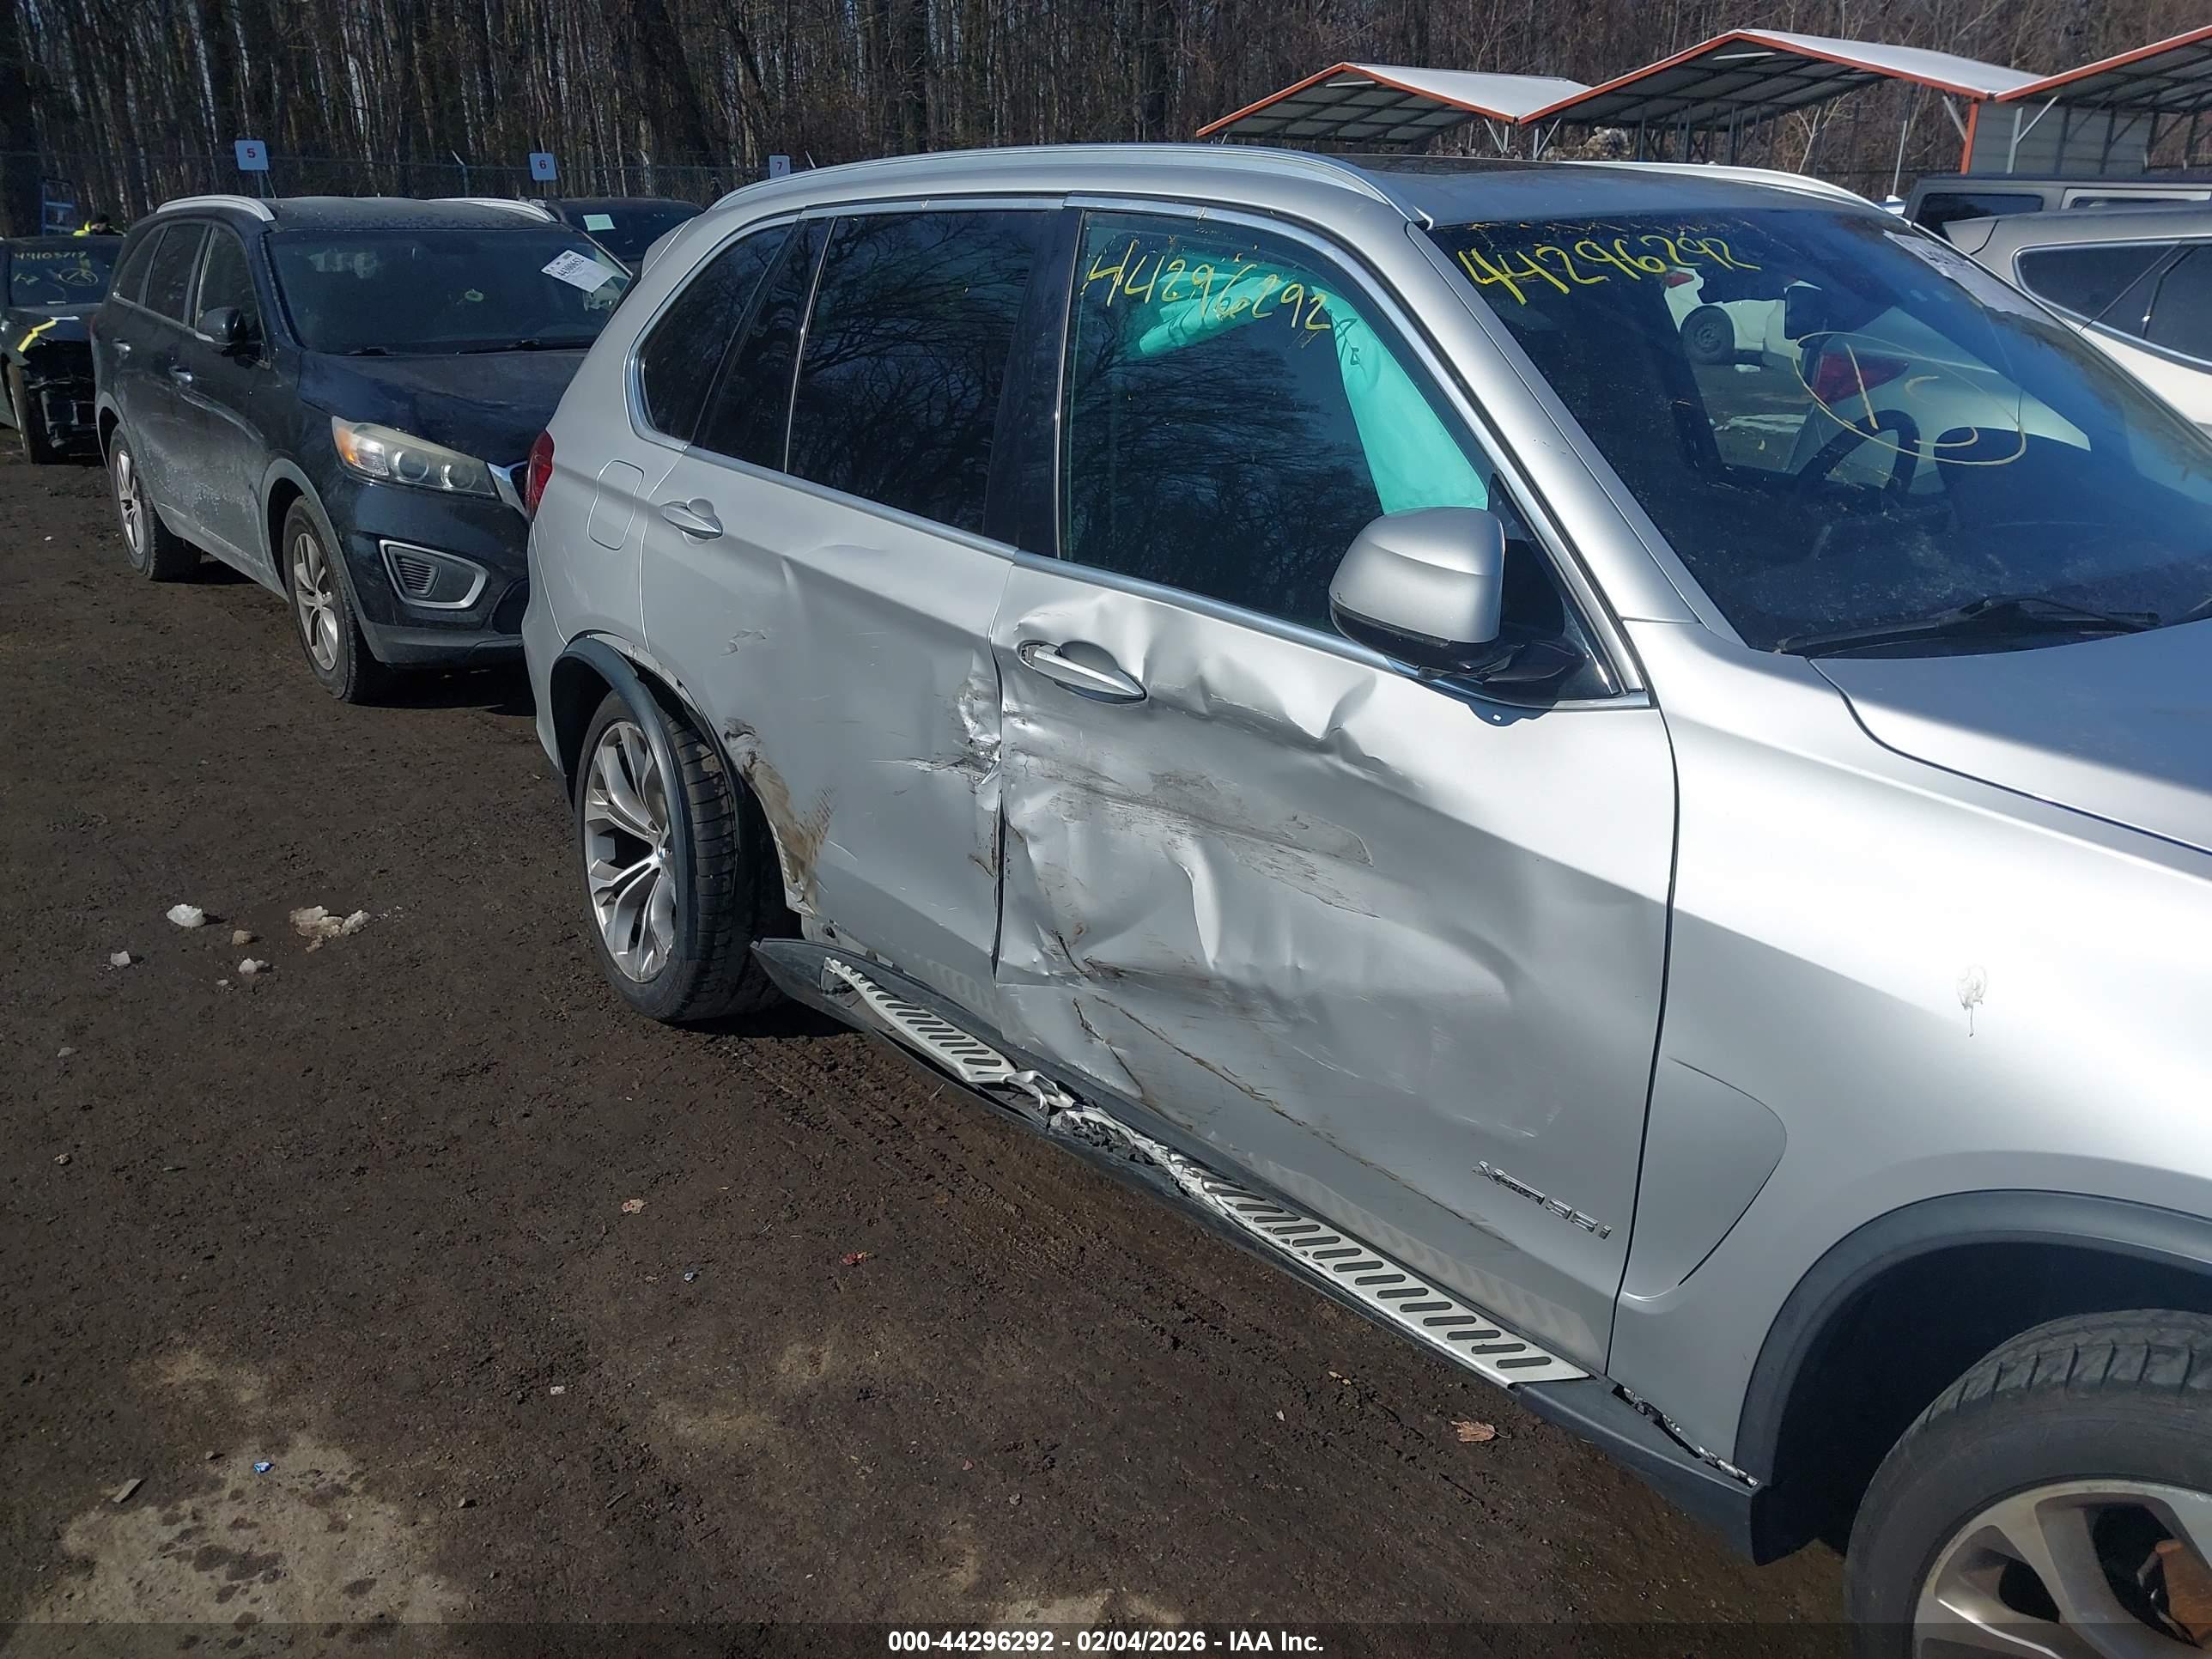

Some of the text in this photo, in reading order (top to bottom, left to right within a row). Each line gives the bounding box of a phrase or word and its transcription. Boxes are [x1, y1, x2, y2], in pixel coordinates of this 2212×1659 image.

[246, 148, 256, 159] 5
[538, 160, 547, 170] 6
[776, 161, 783, 171] 7
[1457, 234, 1761, 305] 44296292
[1079, 240, 1332, 330] 44296292
